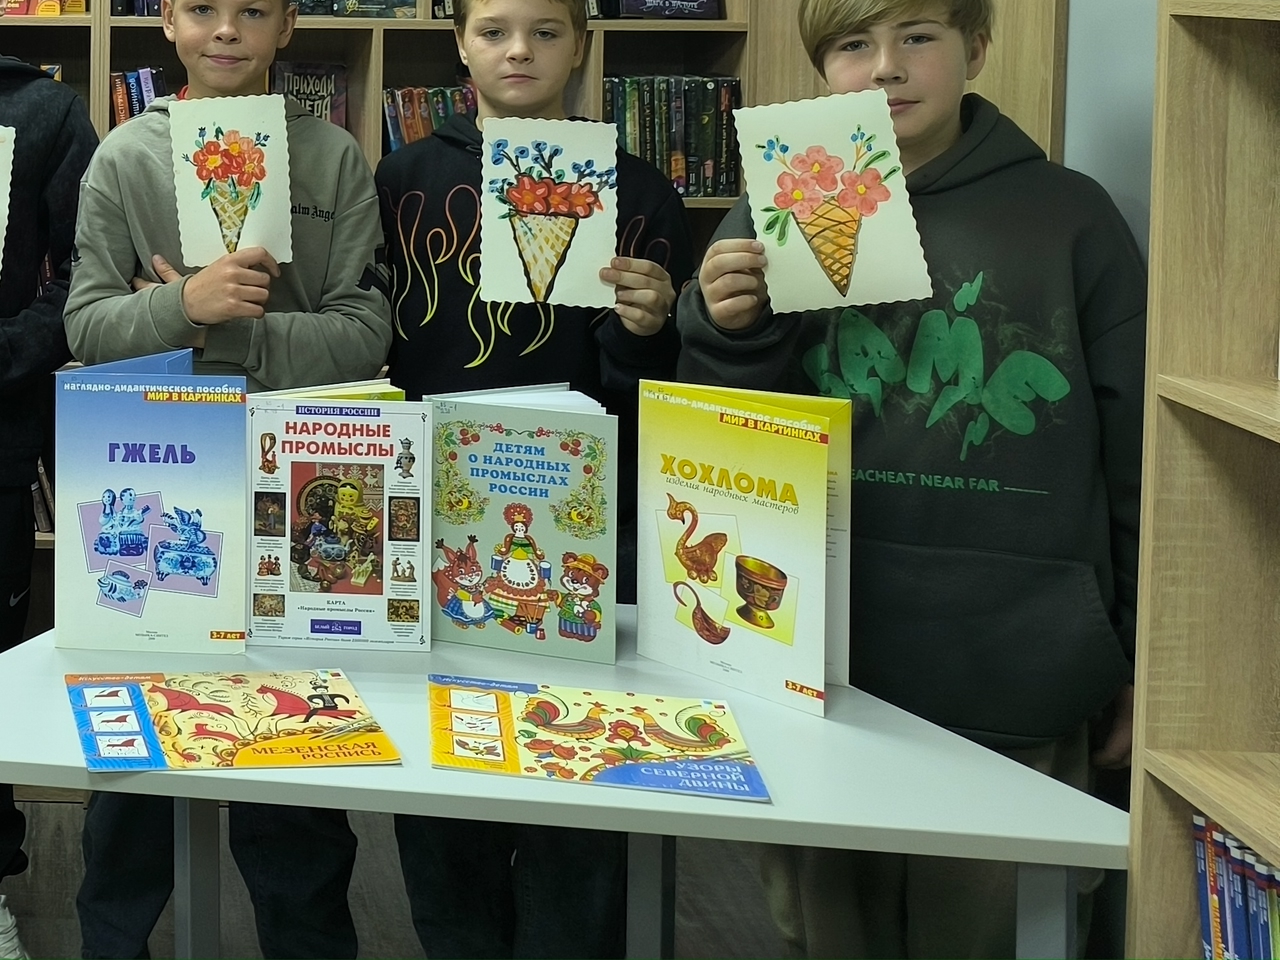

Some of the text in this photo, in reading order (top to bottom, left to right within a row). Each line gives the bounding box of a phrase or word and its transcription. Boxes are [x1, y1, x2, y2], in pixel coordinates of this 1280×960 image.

[283, 72, 335, 96] ПРИХОДИ
[114, 78, 126, 122] ОНСТРУКЦИИ
[127, 77, 140, 116] ИЩНИКОВ
[288, 94, 331, 122] ЧЕРА
[291, 203, 335, 223] alm Ange
[147, 392, 242, 403] МИР В КАРТИНКАХ
[196, 384, 242, 394] пособие
[298, 406, 377, 416] ИСТОРИЯ РОССИИ
[285, 421, 391, 438] НАРОДНЫЕ
[722, 414, 821, 442] МИР В КАРТИНКАХ
[108, 442, 196, 465] ГЖЕЛЬ
[281, 440, 394, 457] ПРОМЫСЛЫ
[493, 442, 545, 456] ДЕТЯМ
[468, 453, 571, 473] О НАРОДНЫХ
[470, 467, 569, 487] ПРОМЫСЛАХ
[660, 453, 799, 506] ХОХЛОМА
[852, 468, 916, 485] EACHEAT
[921, 474, 965, 489] NEAR
[970, 478, 1000, 492] FAR
[488, 482, 550, 498] РОССИИ
[666, 475, 799, 515] изделия народных мастеров
[211, 631, 224, 639] 3-7
[787, 681, 801, 692] 3-7
[251, 742, 378, 755] МЕЗЕНСКАЯ
[301, 749, 382, 760] РОСПИСЬ
[640, 767, 746, 782] СЕВЕРНОЙ
[674, 761, 742, 773] УЗОРЫ
[679, 779, 750, 791] ДВИНЫ
